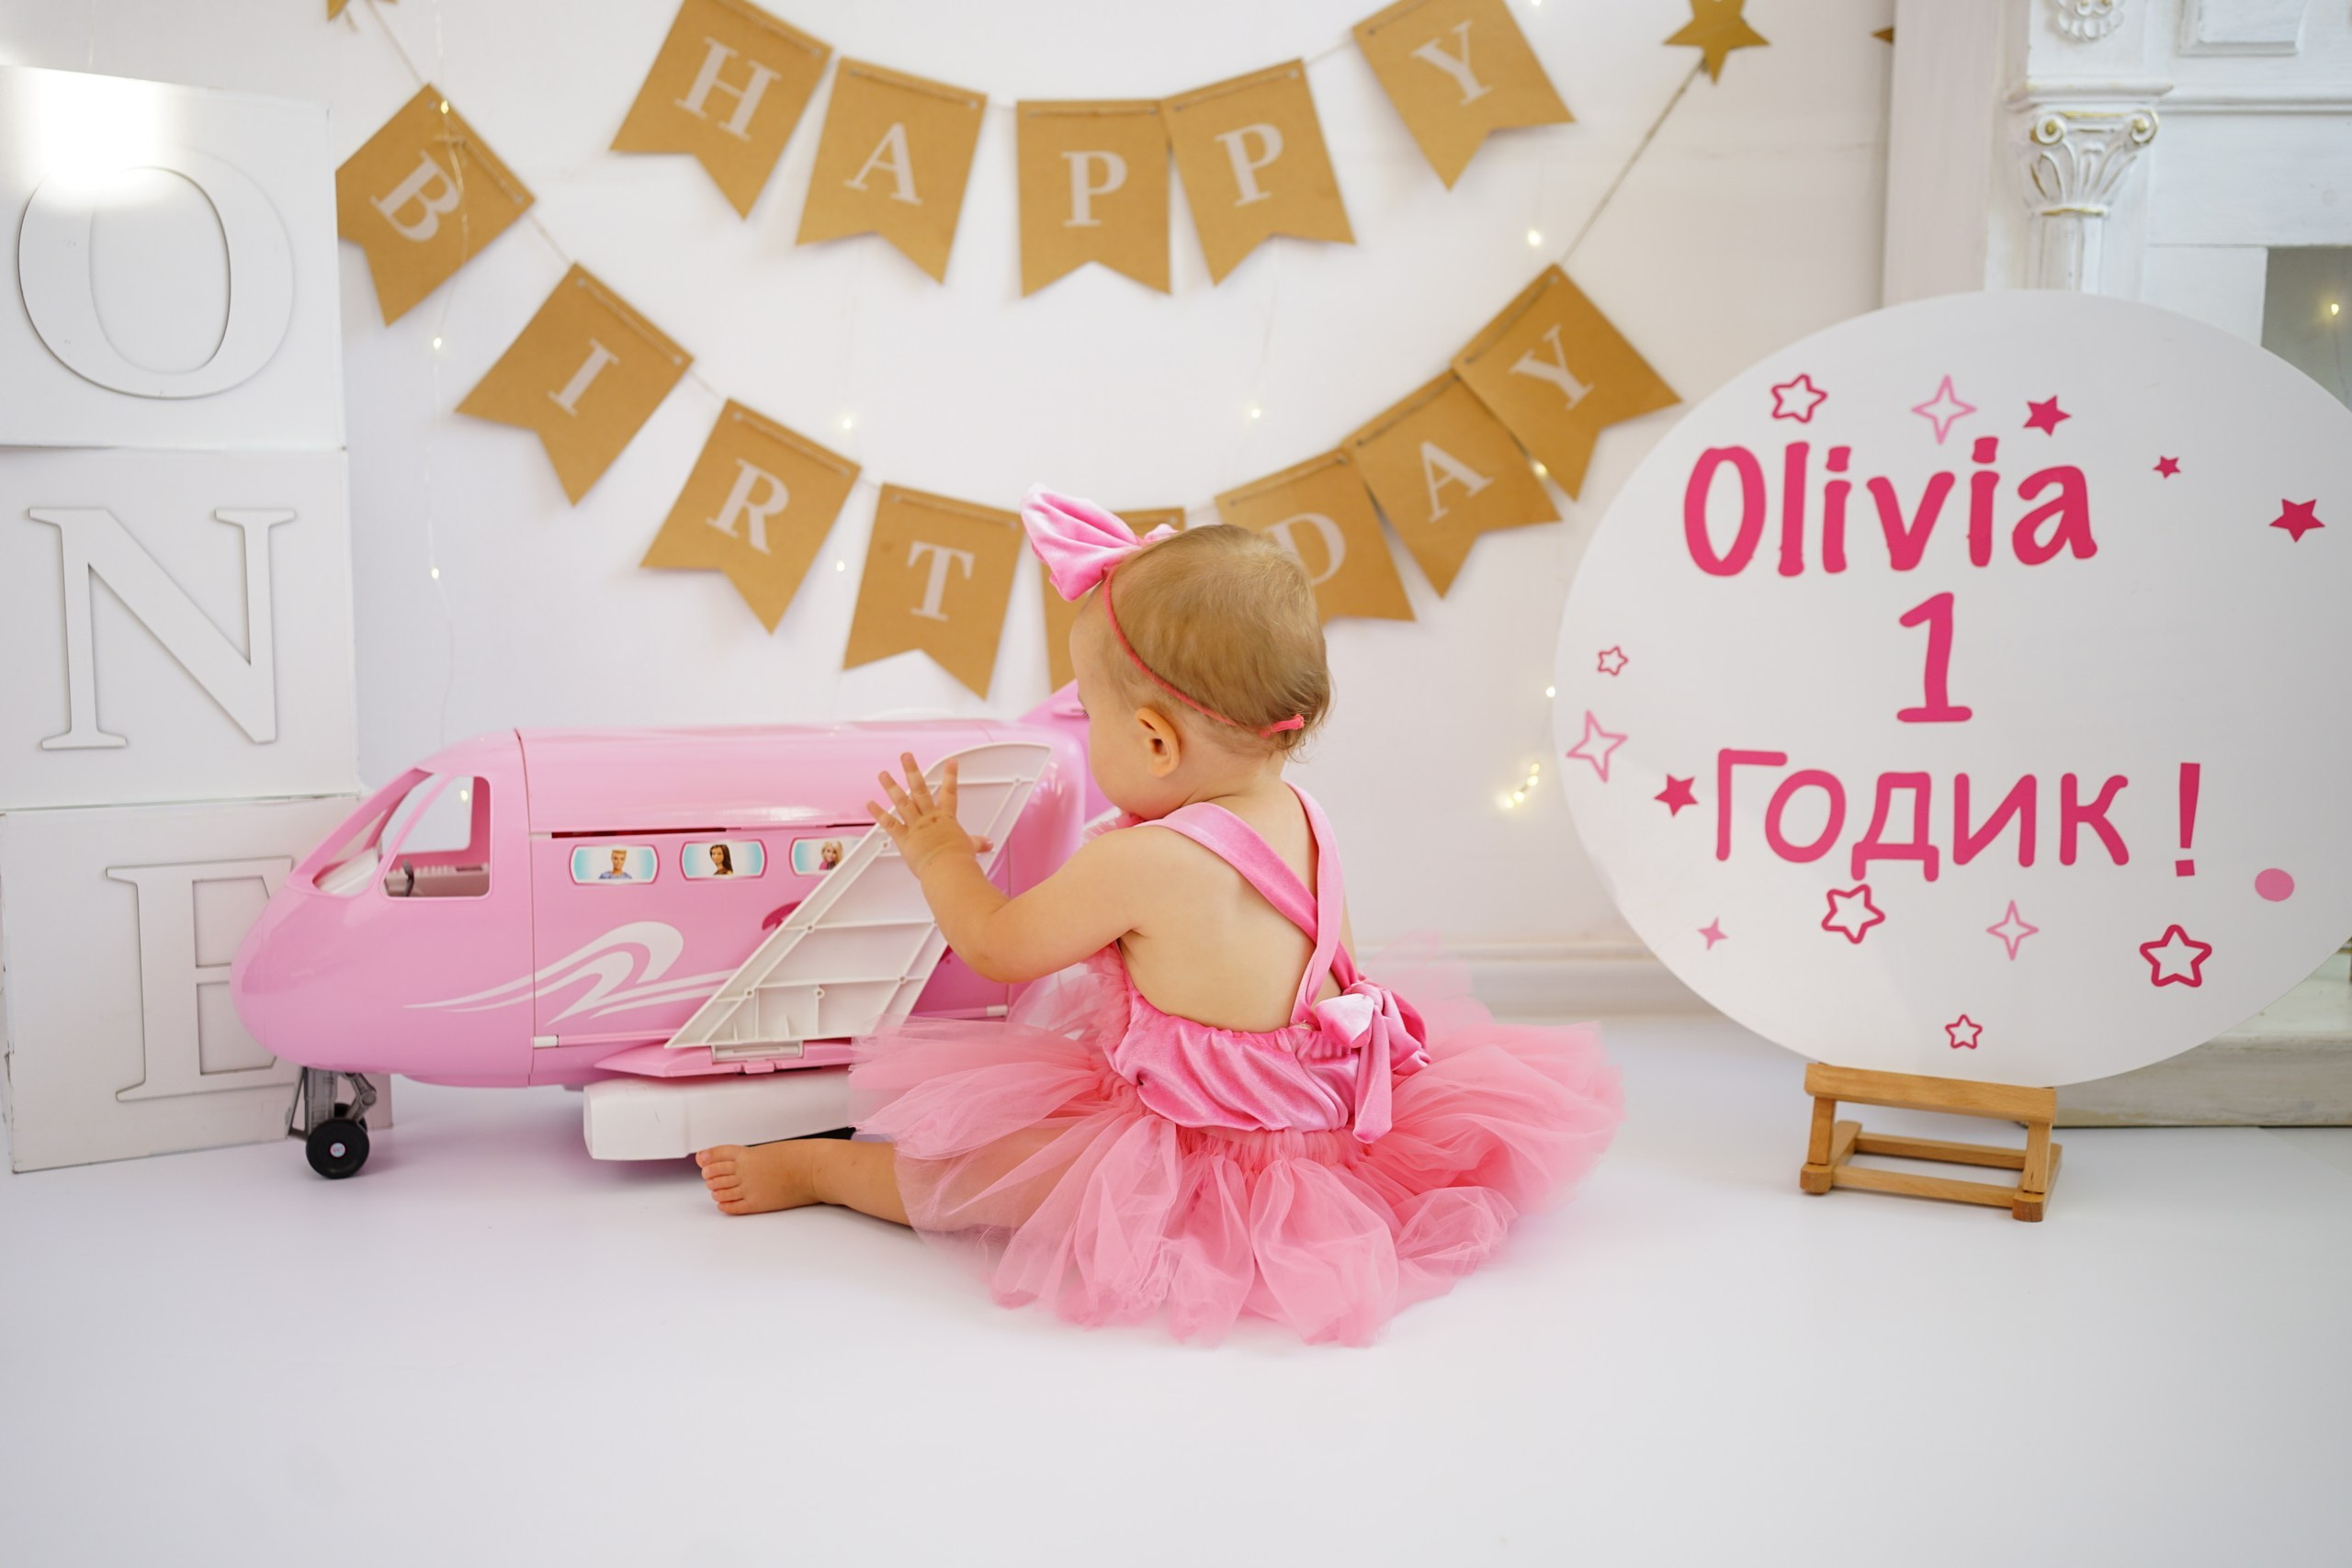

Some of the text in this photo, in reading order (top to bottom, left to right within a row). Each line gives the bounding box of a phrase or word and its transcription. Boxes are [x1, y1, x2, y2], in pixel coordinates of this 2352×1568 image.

[673, 19, 1492, 227] HAPPY
[369, 150, 1593, 622] BIRTDAY
[1683, 436, 2098, 577] Olivia
[1896, 592, 1973, 723] 1
